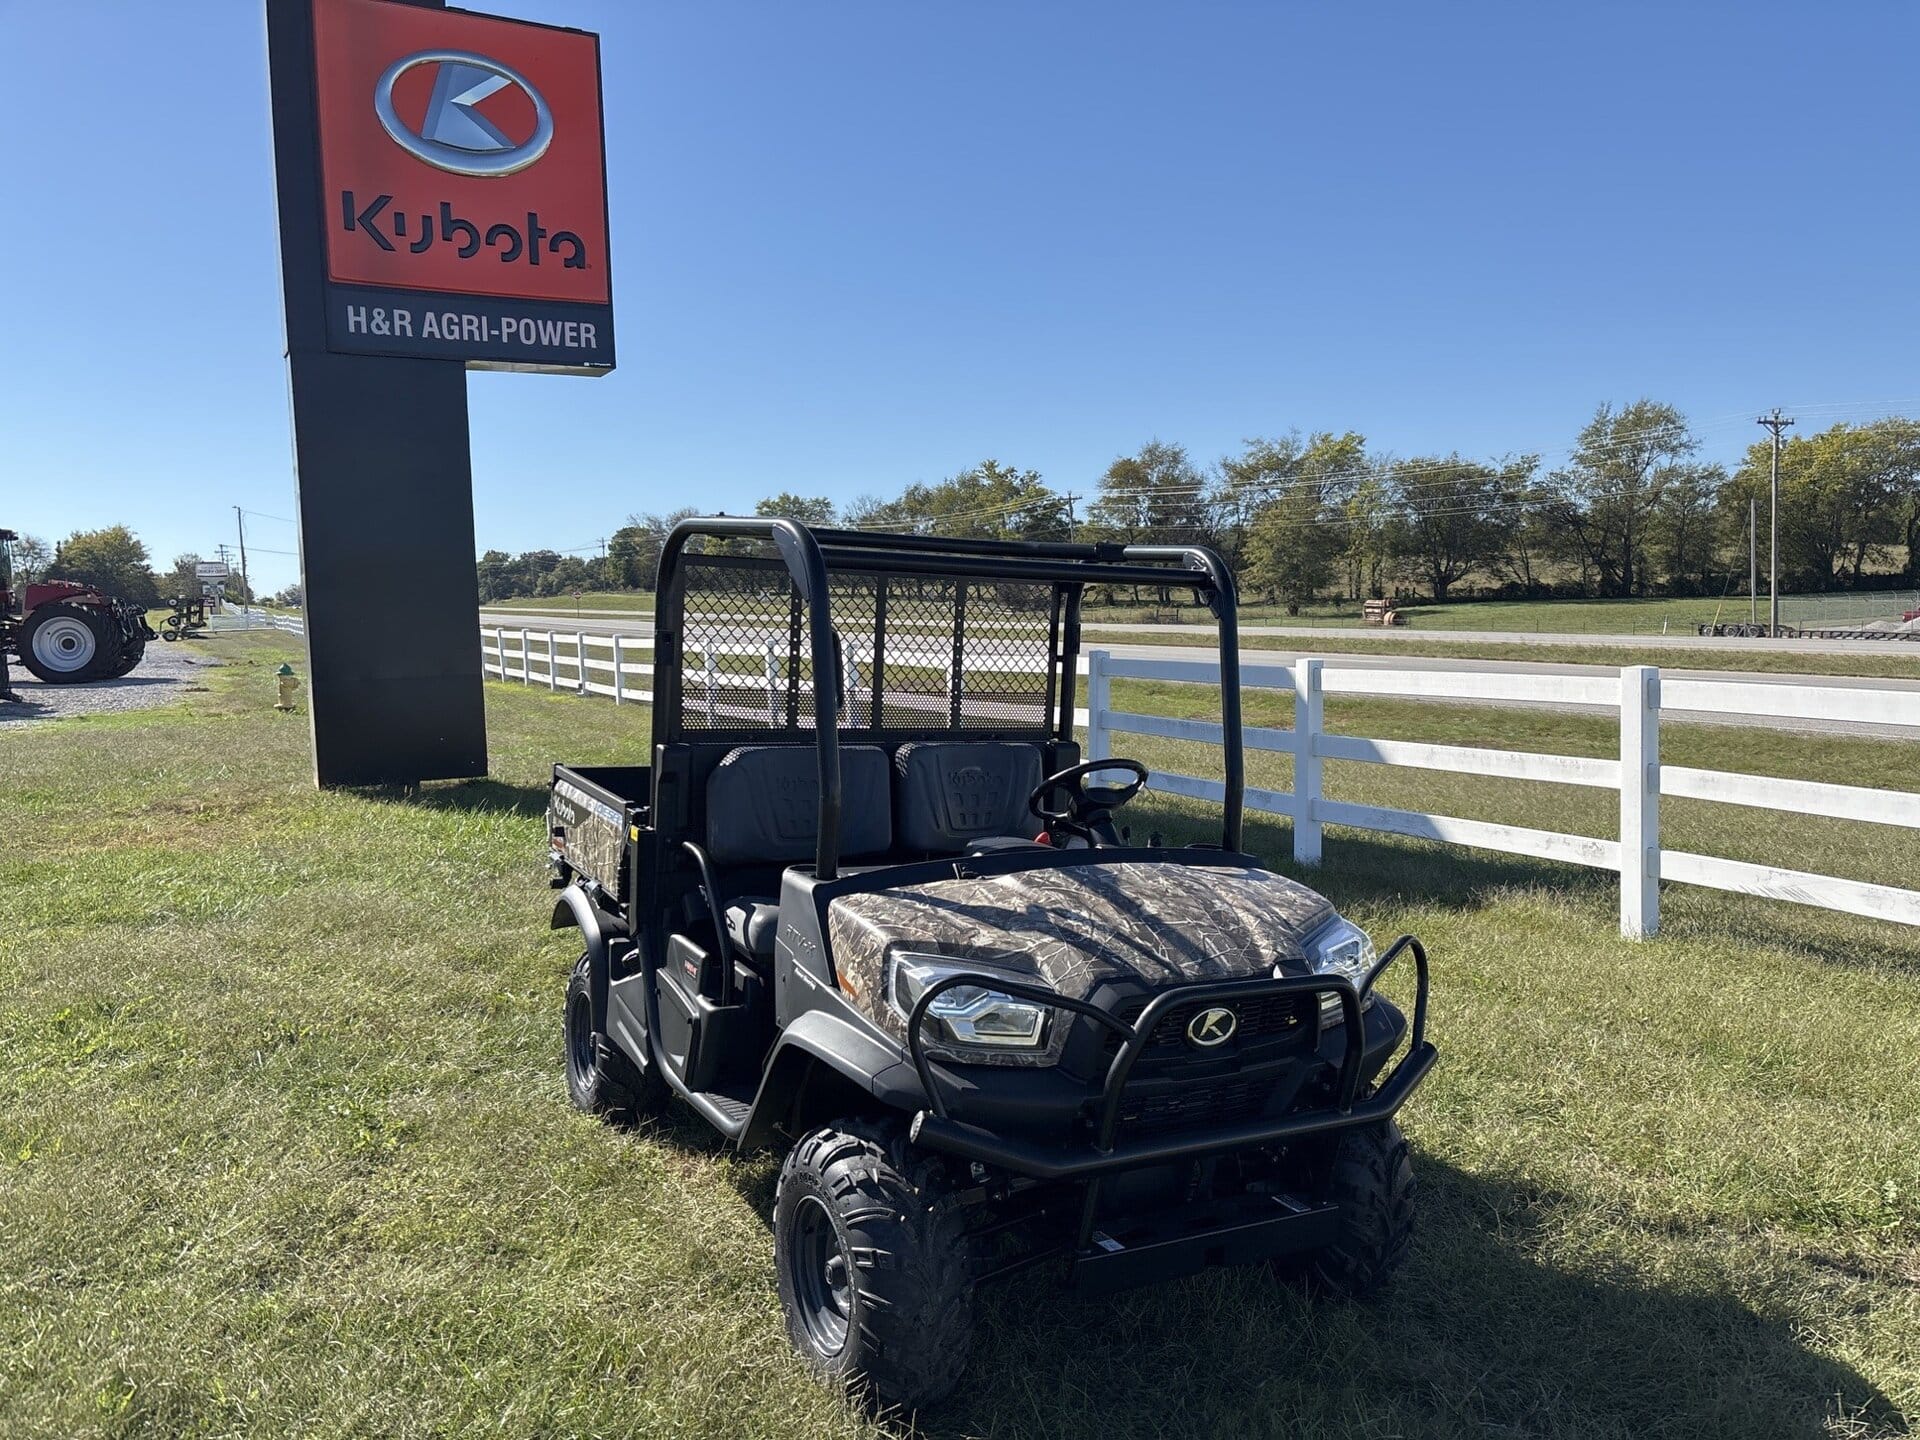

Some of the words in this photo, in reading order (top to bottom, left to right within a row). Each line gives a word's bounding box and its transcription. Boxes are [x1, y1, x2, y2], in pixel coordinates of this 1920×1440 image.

[341, 190, 587, 270] Kubota
[346, 305, 413, 338] H&R
[421, 312, 597, 349] AGRI-POWER
